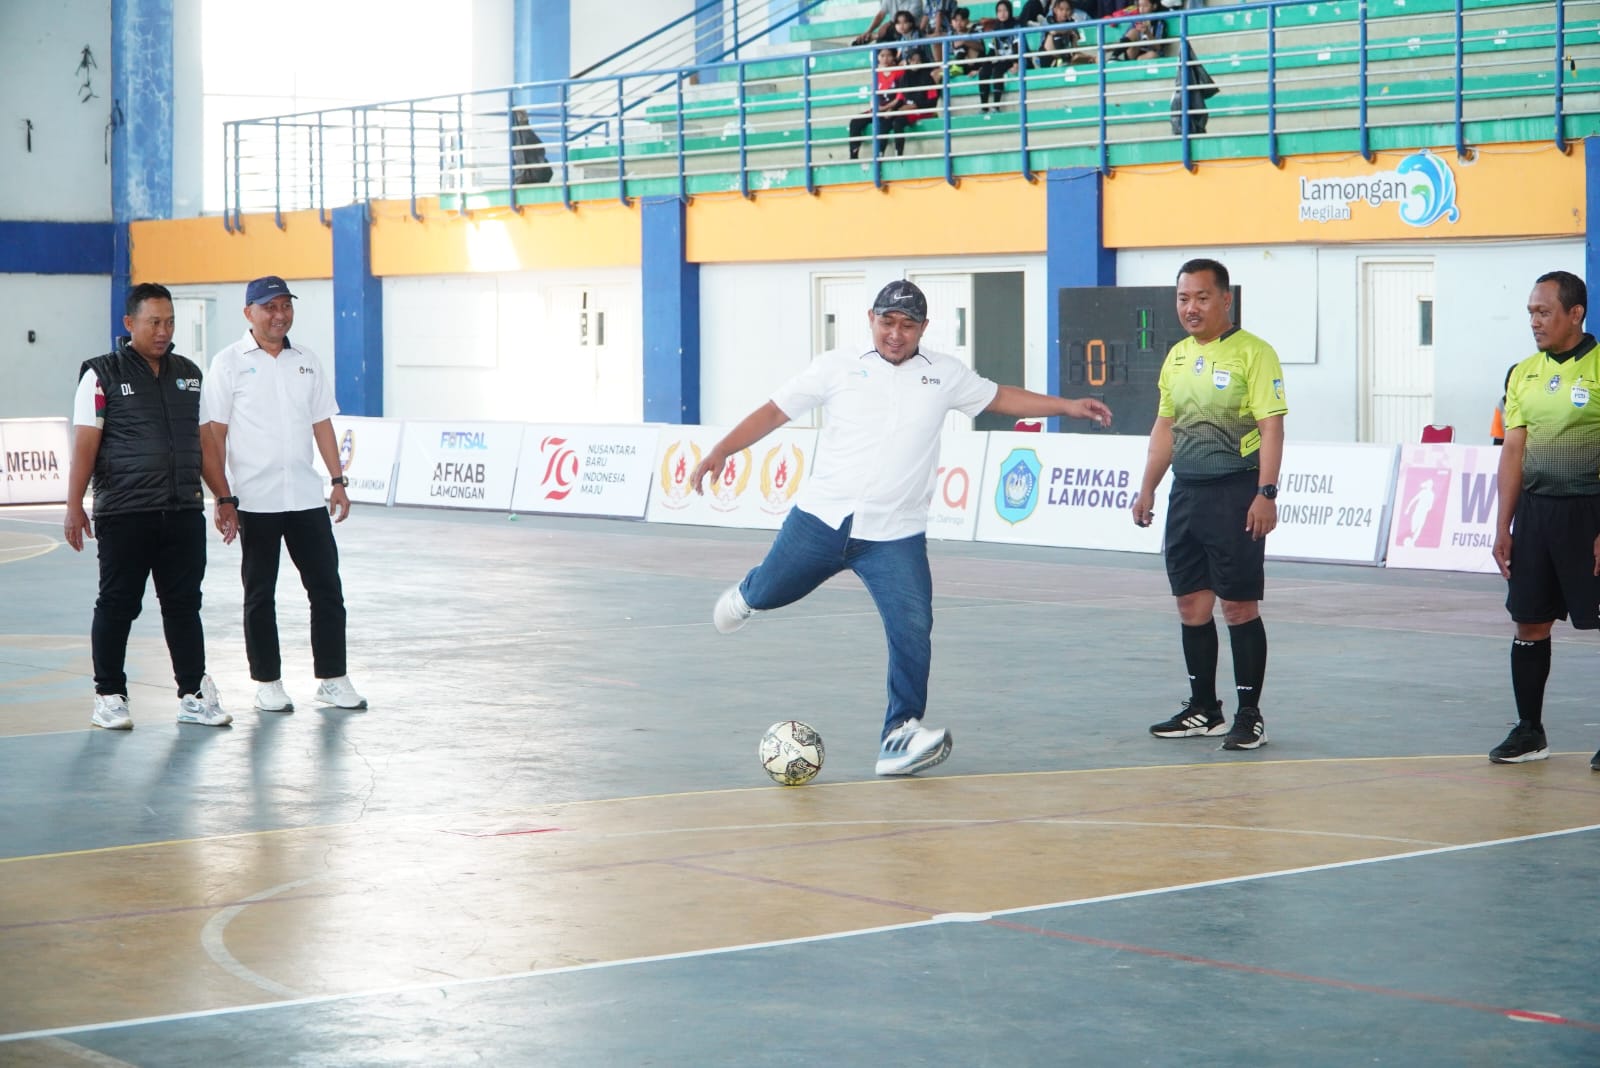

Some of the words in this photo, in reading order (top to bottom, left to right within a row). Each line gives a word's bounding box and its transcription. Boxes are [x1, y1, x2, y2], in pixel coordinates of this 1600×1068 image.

[1301, 179, 1407, 205] Lamongan
[121, 382, 135, 396] DL
[588, 444, 636, 456] NUSANTARA
[7, 450, 58, 472] MEDIA
[585, 456, 608, 467] BARU
[433, 462, 485, 483] AFKAB
[583, 471, 625, 483] INDONESIA
[1050, 467, 1130, 488] PEMKAB
[581, 484, 603, 495] MAJU
[1286, 473, 1334, 494] FUTSAL
[430, 484, 485, 500] LAMONGAN
[1336, 506, 1372, 528] 2024
[1451, 532, 1493, 548] FUTSAL
